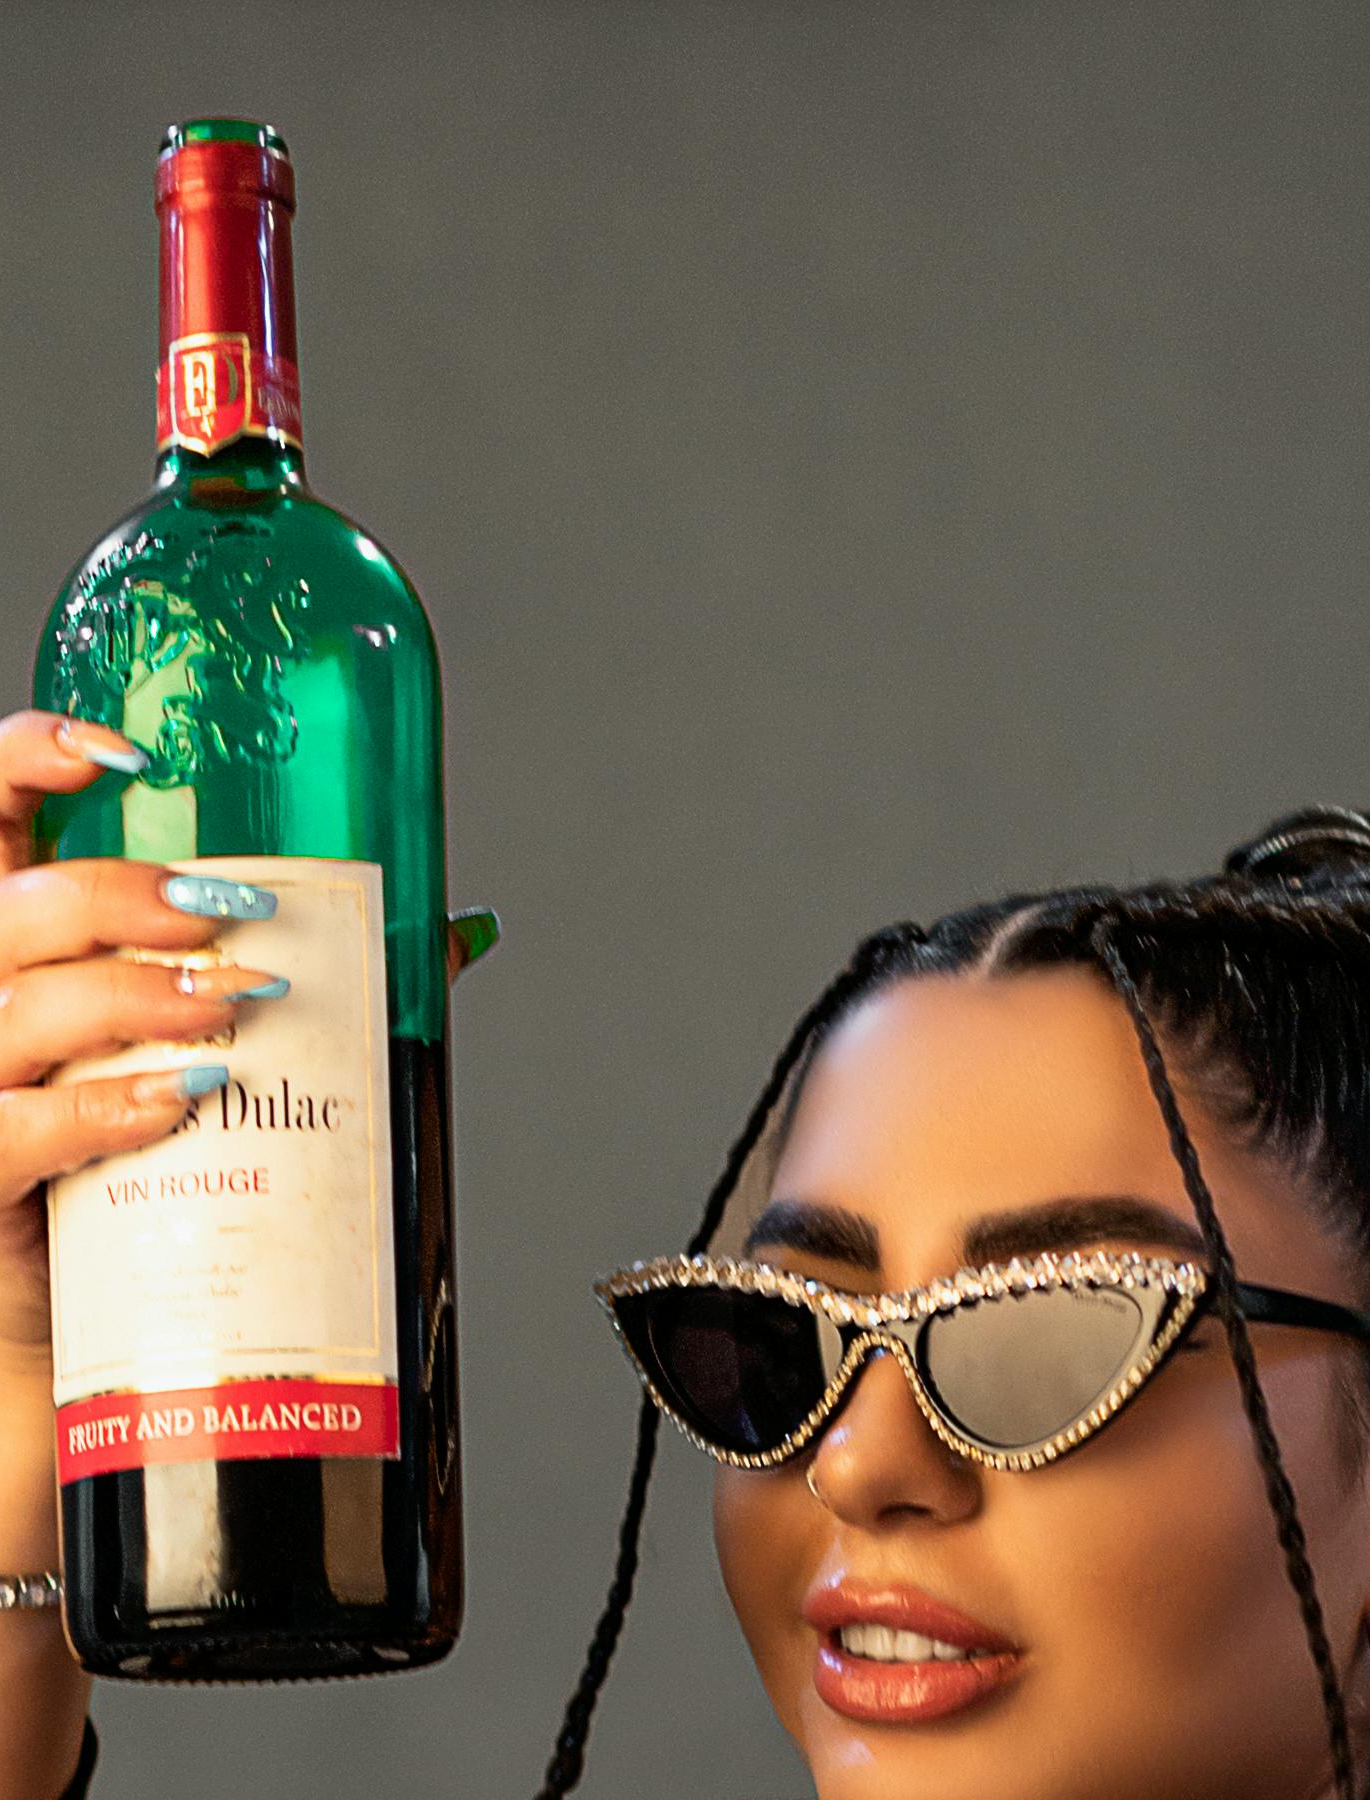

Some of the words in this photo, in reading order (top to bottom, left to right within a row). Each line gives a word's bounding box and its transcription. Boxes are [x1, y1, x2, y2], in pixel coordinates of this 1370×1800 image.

[218, 1077, 341, 1132] Dulac
[106, 1176, 150, 1206] VIN
[159, 1166, 270, 1198] ROUGE
[67, 1413, 132, 1455] FRUITY
[135, 1403, 196, 1441] AND
[202, 1401, 363, 1434] BALANCED
